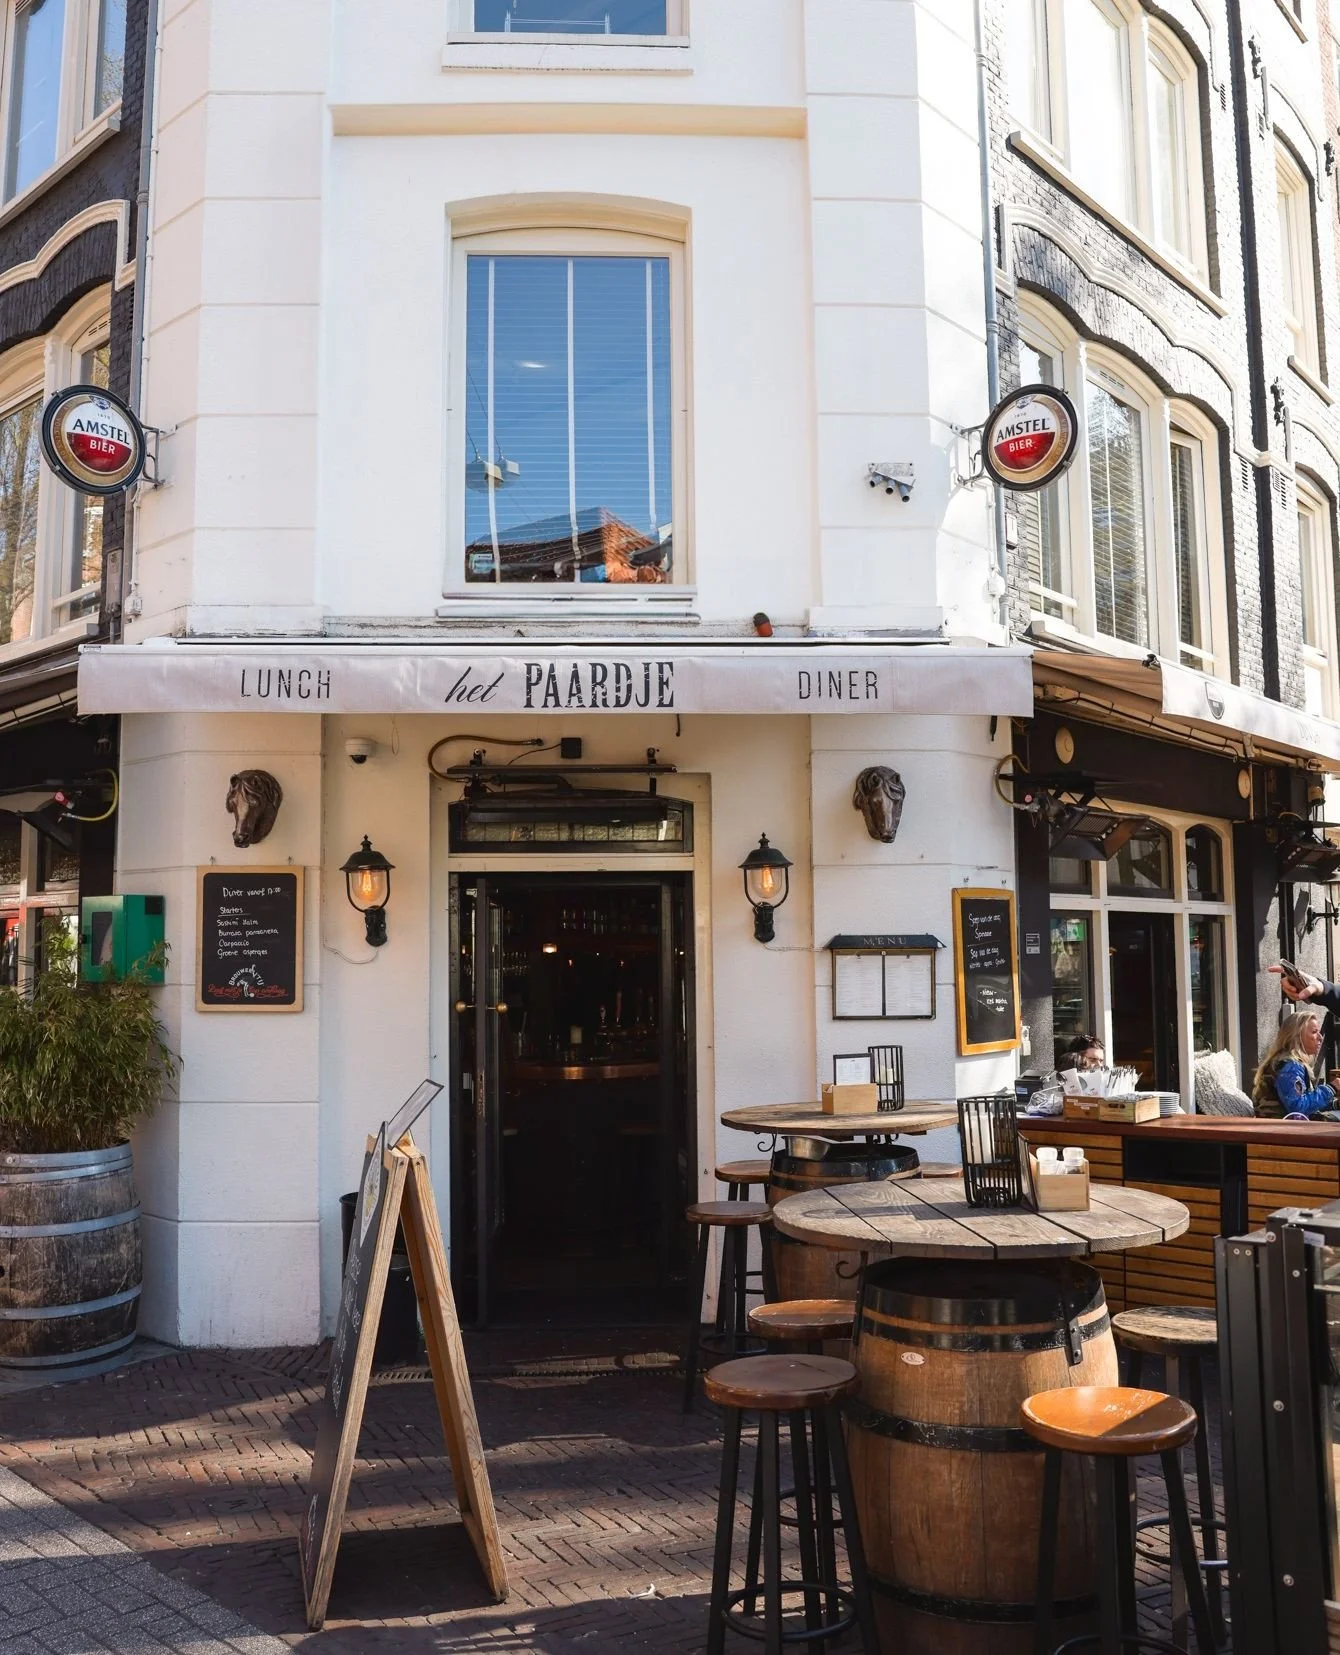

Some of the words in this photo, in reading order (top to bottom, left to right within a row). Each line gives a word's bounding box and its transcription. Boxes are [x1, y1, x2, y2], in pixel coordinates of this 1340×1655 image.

[73, 419, 130, 445] AMSTEL
[997, 418, 1050, 443] AMSTEL
[90, 440, 116, 454] BIER
[1009, 438, 1033, 452] BIER
[241, 669, 331, 699] LUNCH
[444, 666, 505, 703] het
[523, 661, 674, 708] PAARDJE
[798, 671, 879, 700] DINER
[863, 937, 907, 946] MENU
